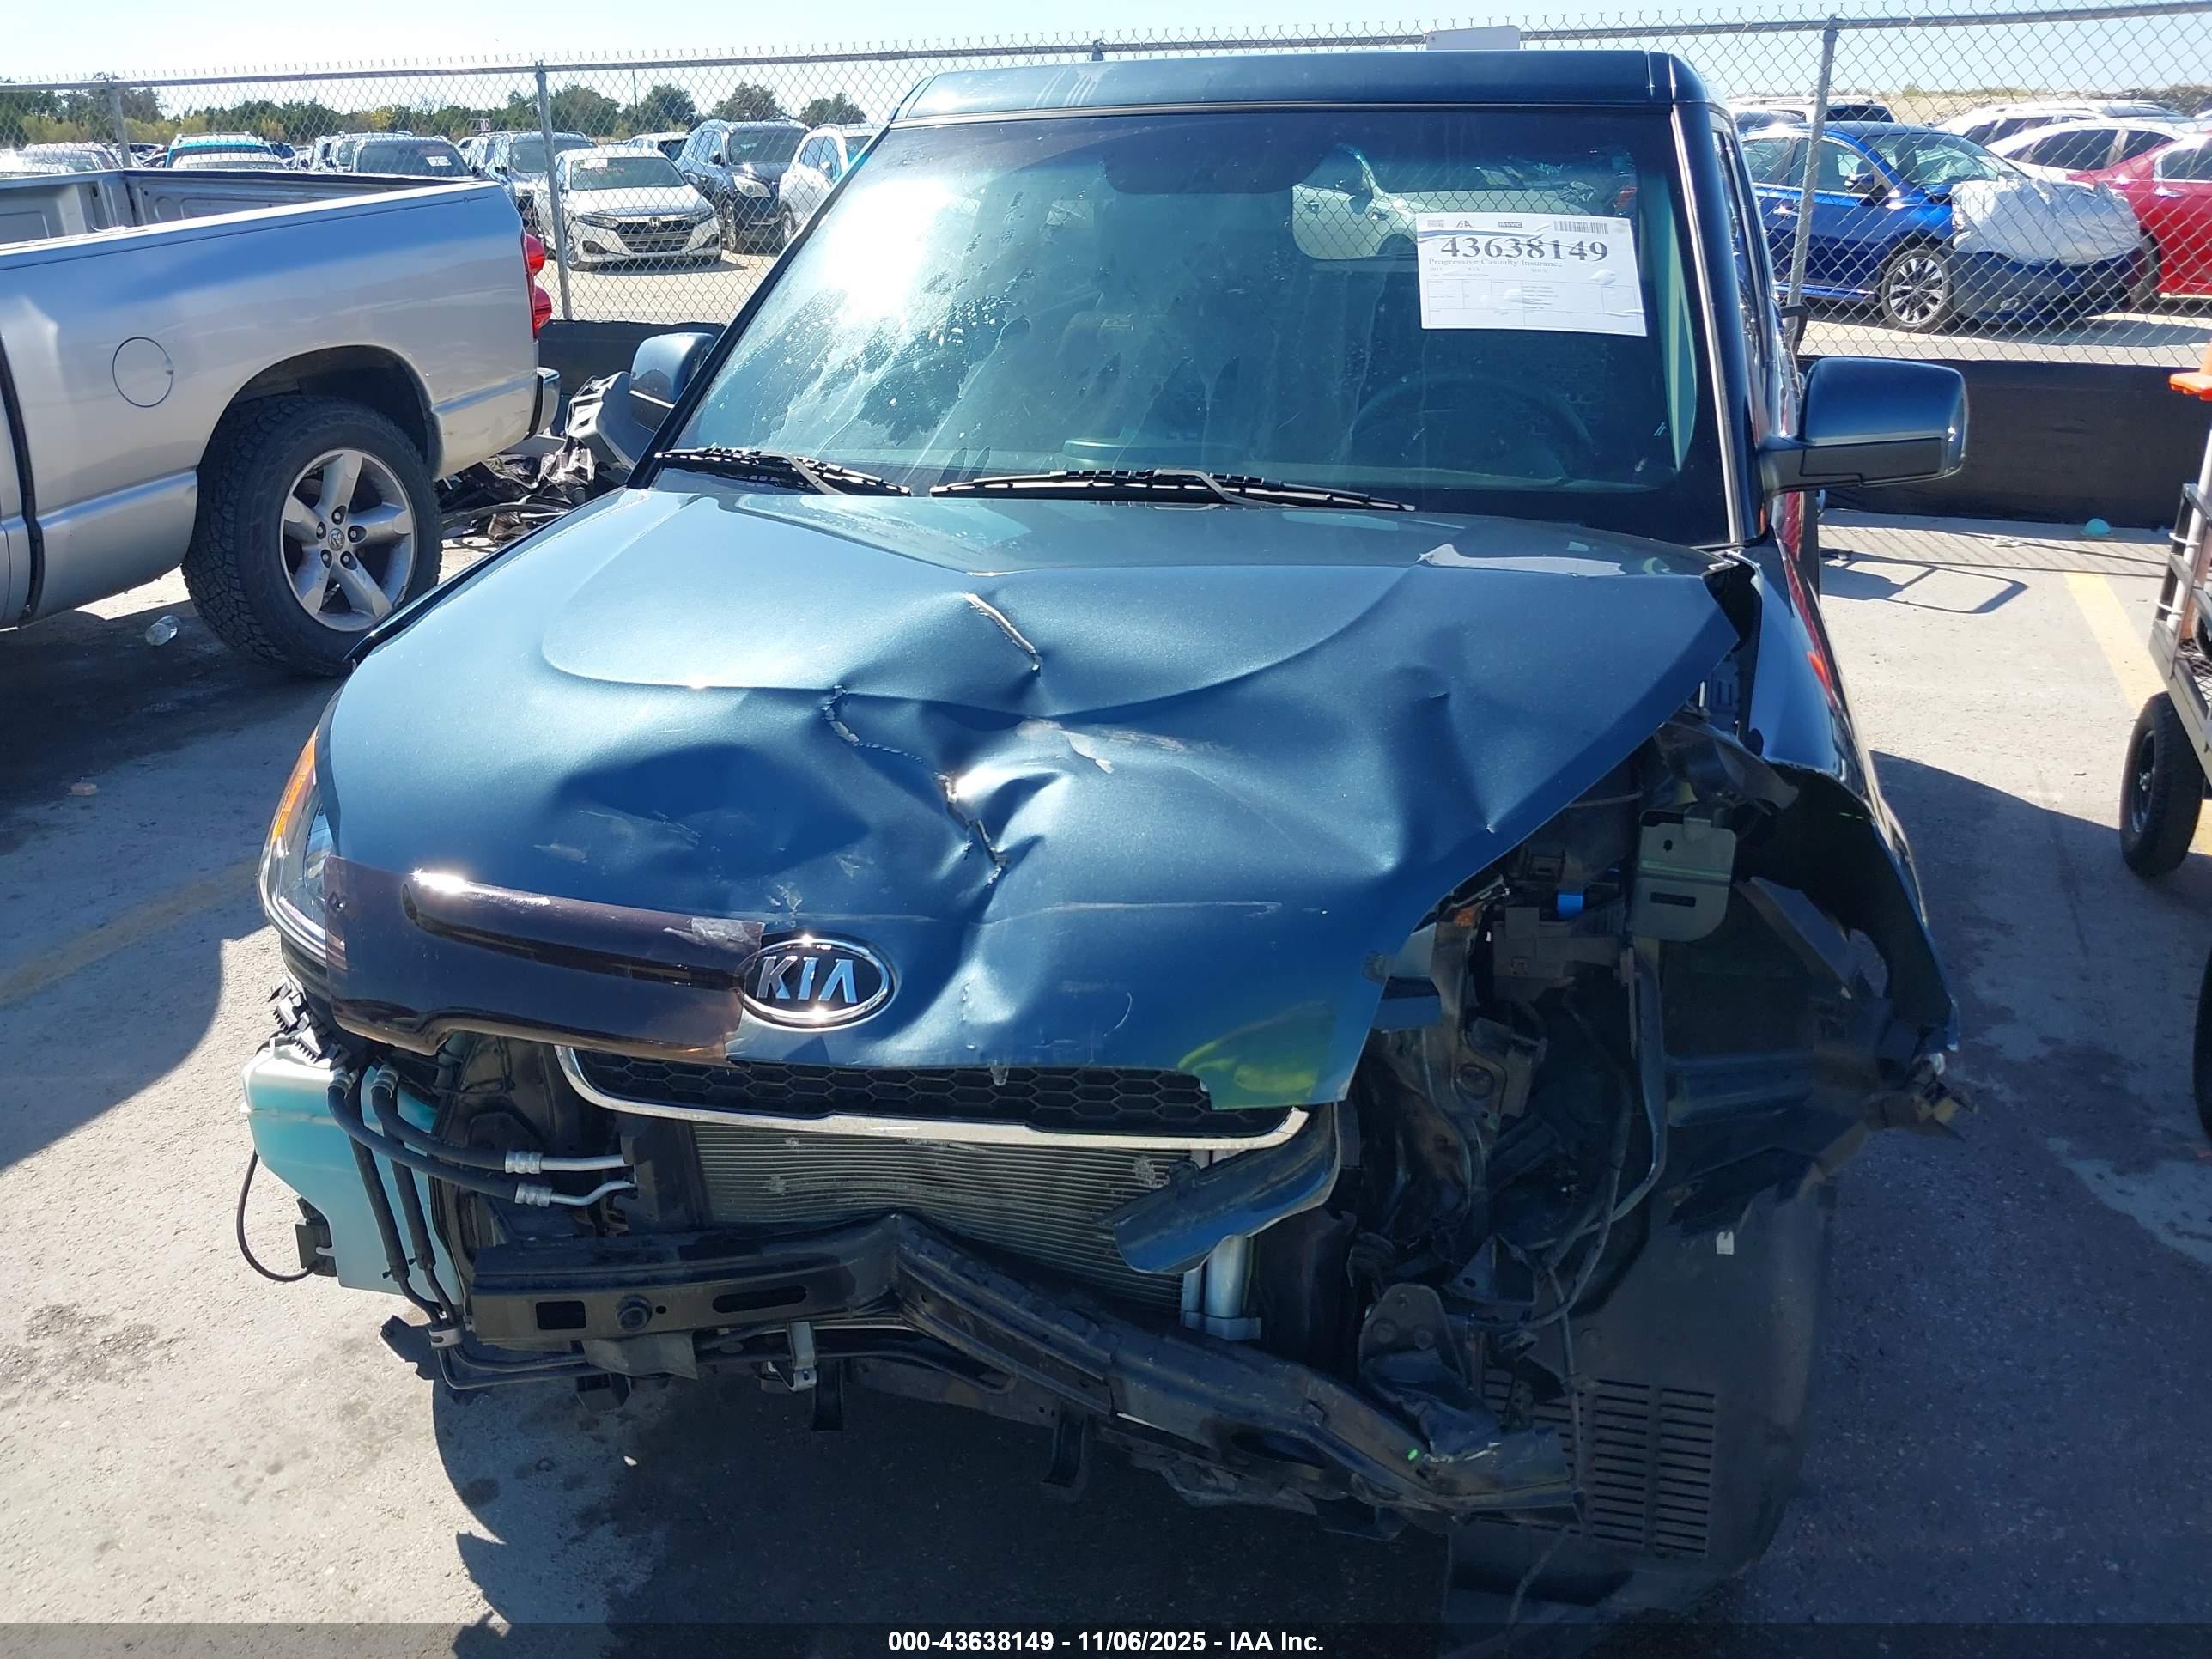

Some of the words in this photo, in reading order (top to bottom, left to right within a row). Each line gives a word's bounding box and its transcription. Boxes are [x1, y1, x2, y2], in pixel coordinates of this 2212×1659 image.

[1441, 236, 1608, 262] 43638149
[1522, 259, 1563, 268] Insurance
[757, 956, 858, 1003] KIA
